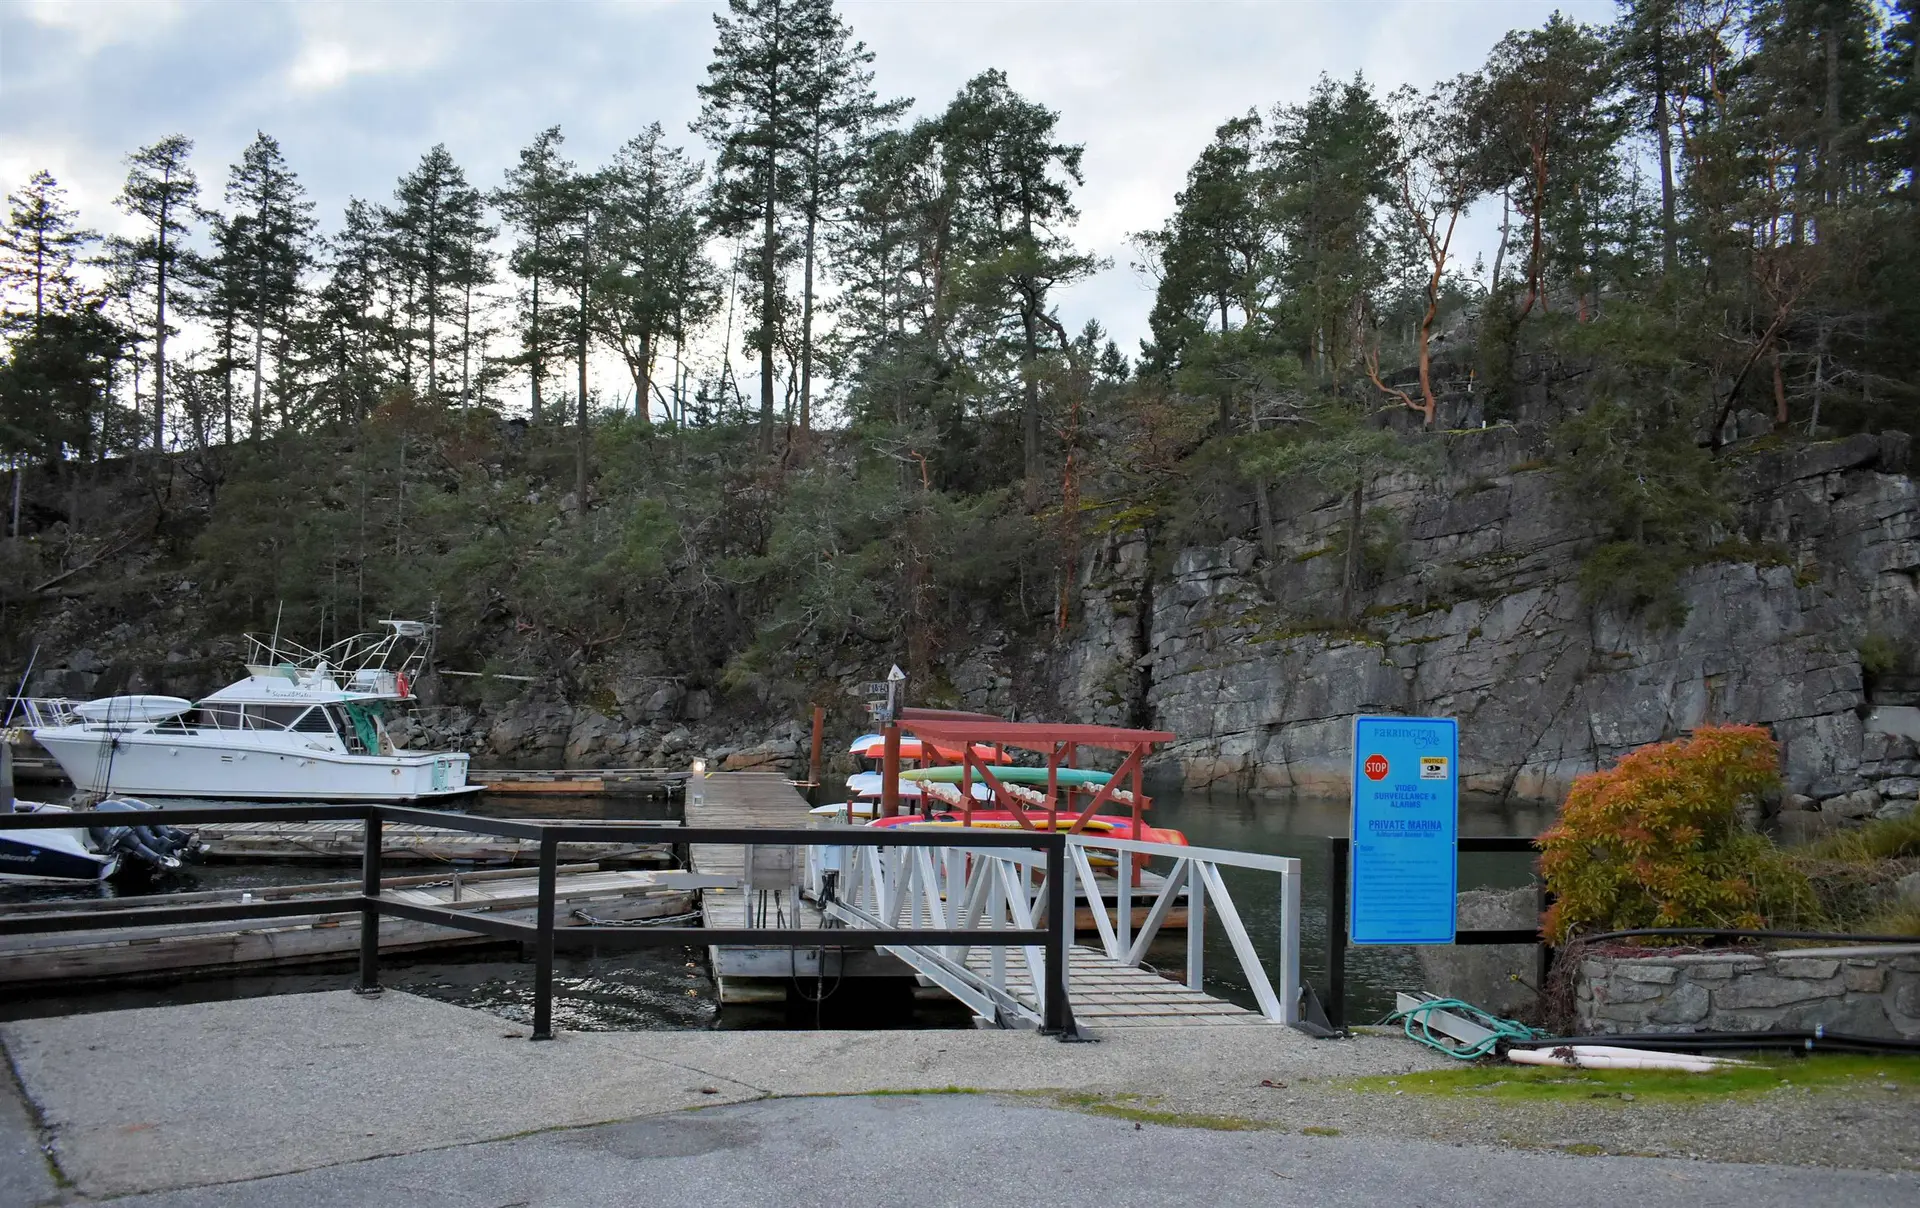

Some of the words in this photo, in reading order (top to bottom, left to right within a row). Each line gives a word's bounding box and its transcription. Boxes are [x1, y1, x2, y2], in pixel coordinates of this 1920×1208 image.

[1366, 762, 1387, 773] STOP
[1394, 784, 1417, 792] VIDEO
[1374, 792, 1429, 800] SURVEILLANCE
[1390, 800, 1421, 808] ALARMS
[1369, 820, 1405, 830] PRIVATE
[1407, 820, 1442, 830] MARINA
